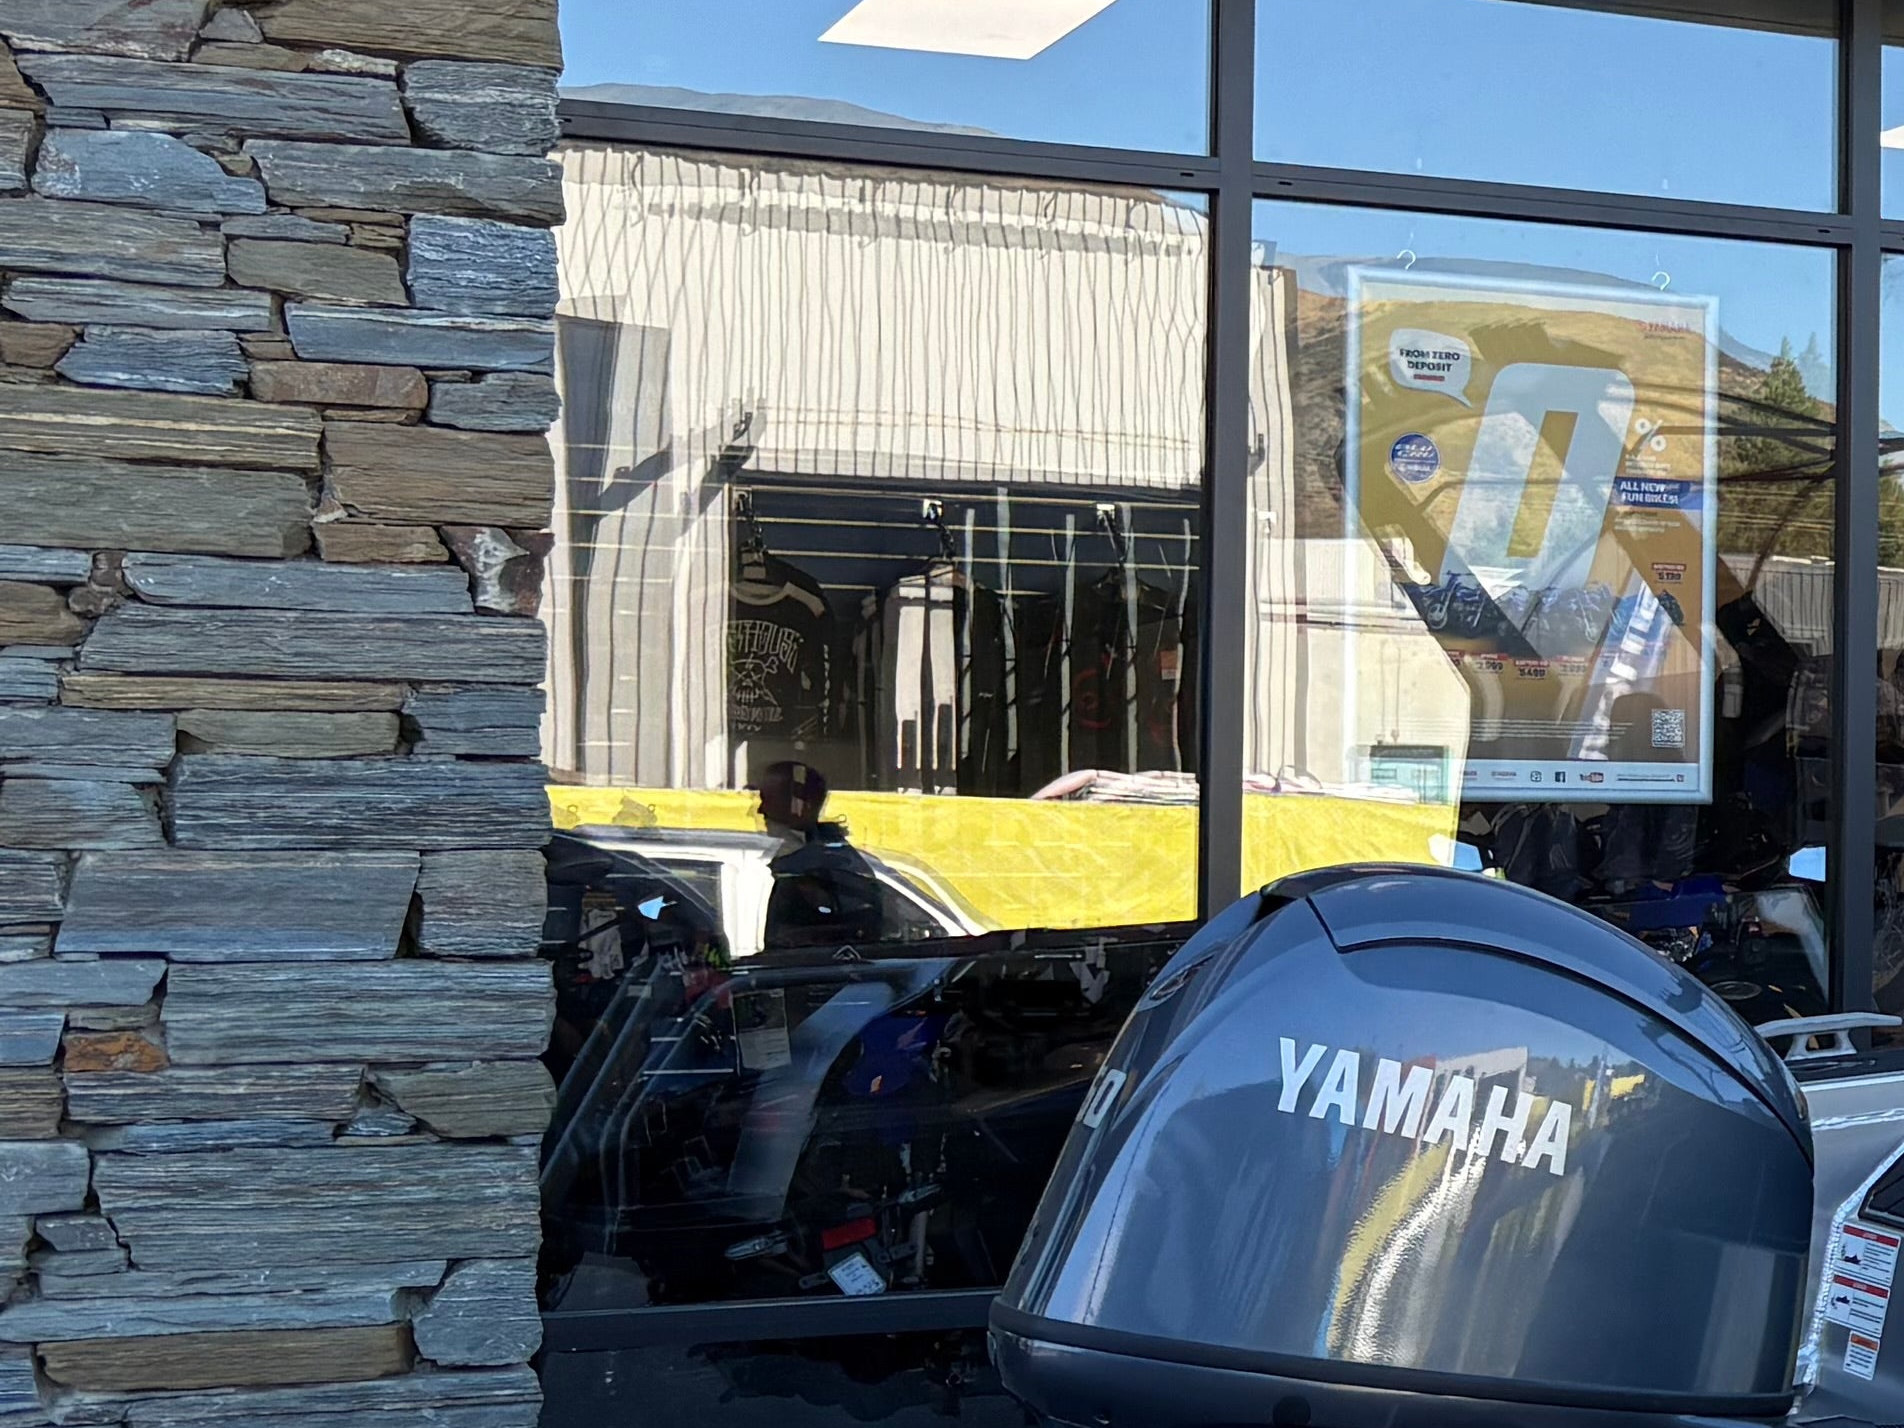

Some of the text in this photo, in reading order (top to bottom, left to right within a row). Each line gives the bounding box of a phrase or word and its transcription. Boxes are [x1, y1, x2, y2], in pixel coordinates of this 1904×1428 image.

[1400, 349, 1461, 362] FROM ZERO
[1407, 360, 1453, 372] DEPOSIT
[1620, 481, 1666, 493] ALL NEW
[1277, 1037, 1573, 1176] YAMAHA
